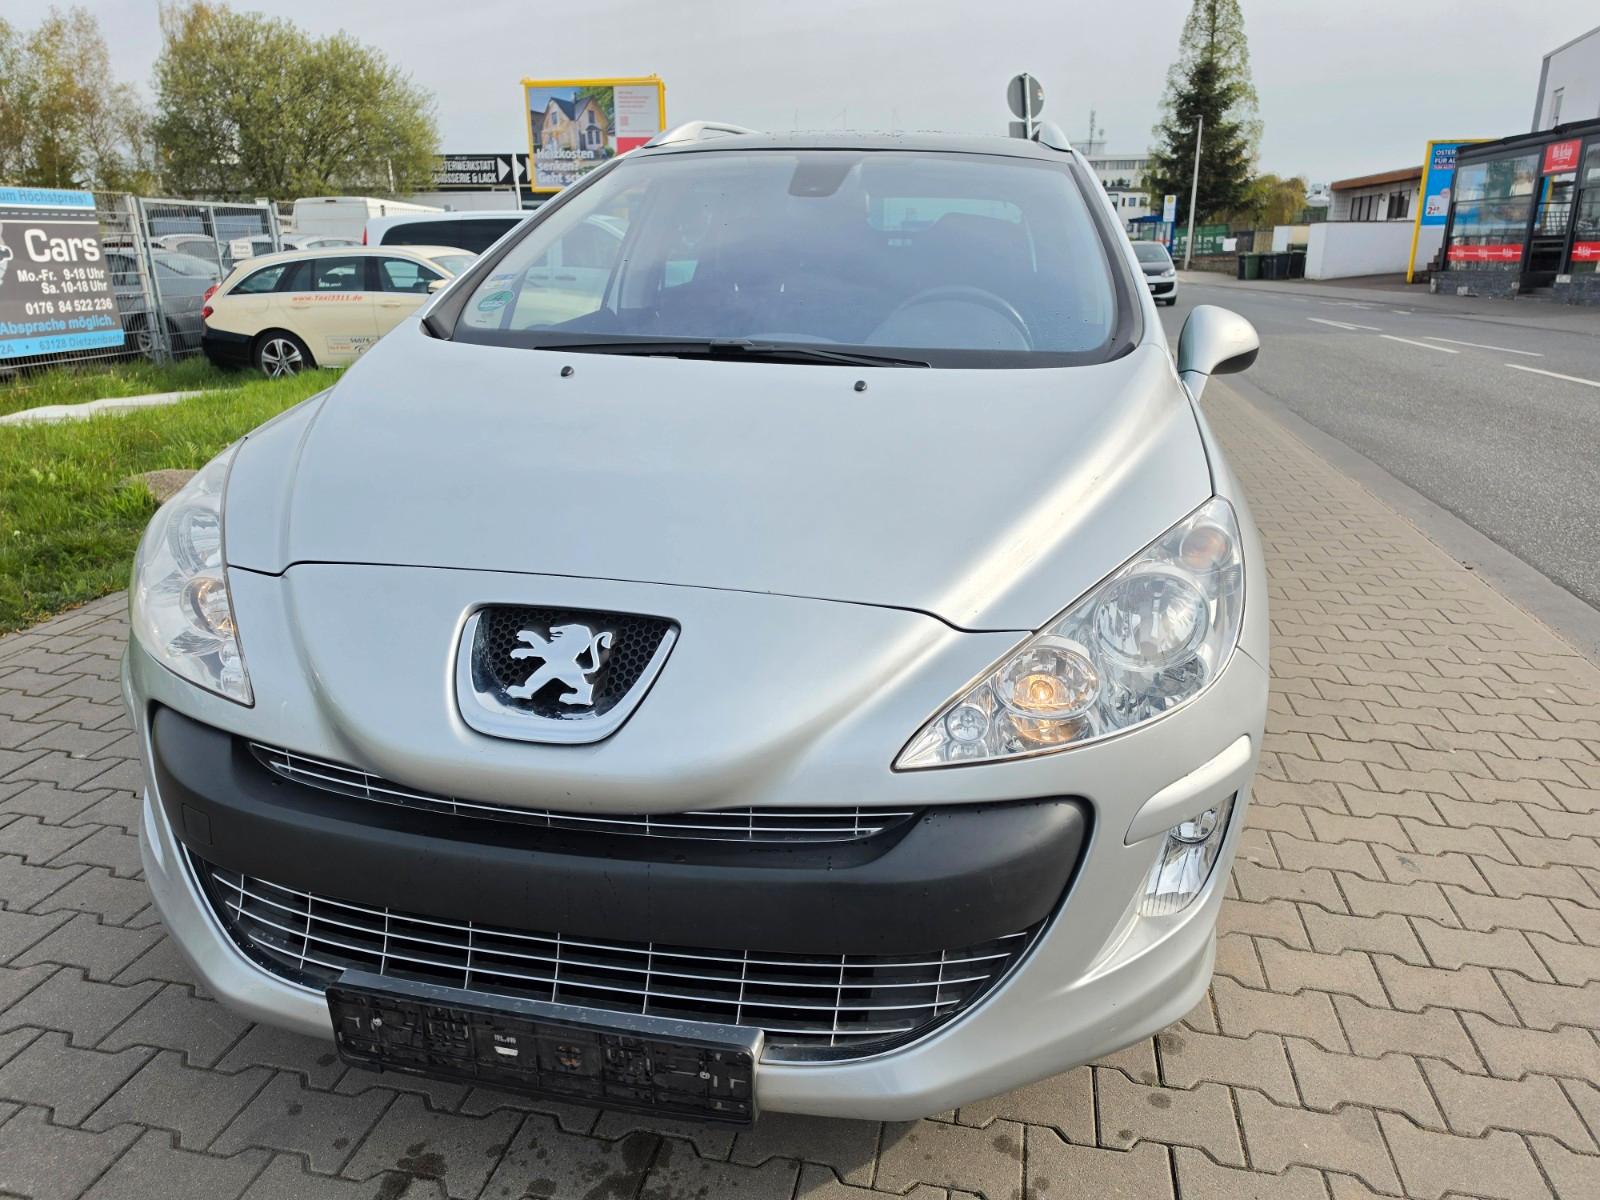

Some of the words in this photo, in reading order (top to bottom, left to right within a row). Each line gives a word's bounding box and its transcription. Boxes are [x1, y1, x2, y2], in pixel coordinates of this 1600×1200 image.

[478, 172, 497, 183] LACK
[24, 228, 100, 262] Cars
[17, 269, 57, 282] Mo.-Fr.
[63, 268, 86, 280] 9-18
[86, 267, 105, 280] Uhr
[41, 282, 59, 294] Sa.
[61, 281, 89, 293] 10-18
[89, 280, 108, 292] Uhr
[25, 301, 54, 315] 0176
[58, 300, 72, 313] 84
[74, 299, 93, 312] 522
[94, 298, 113, 310] 236
[0, 317, 66, 335] Absprache
[68, 314, 116, 330] möglich.
